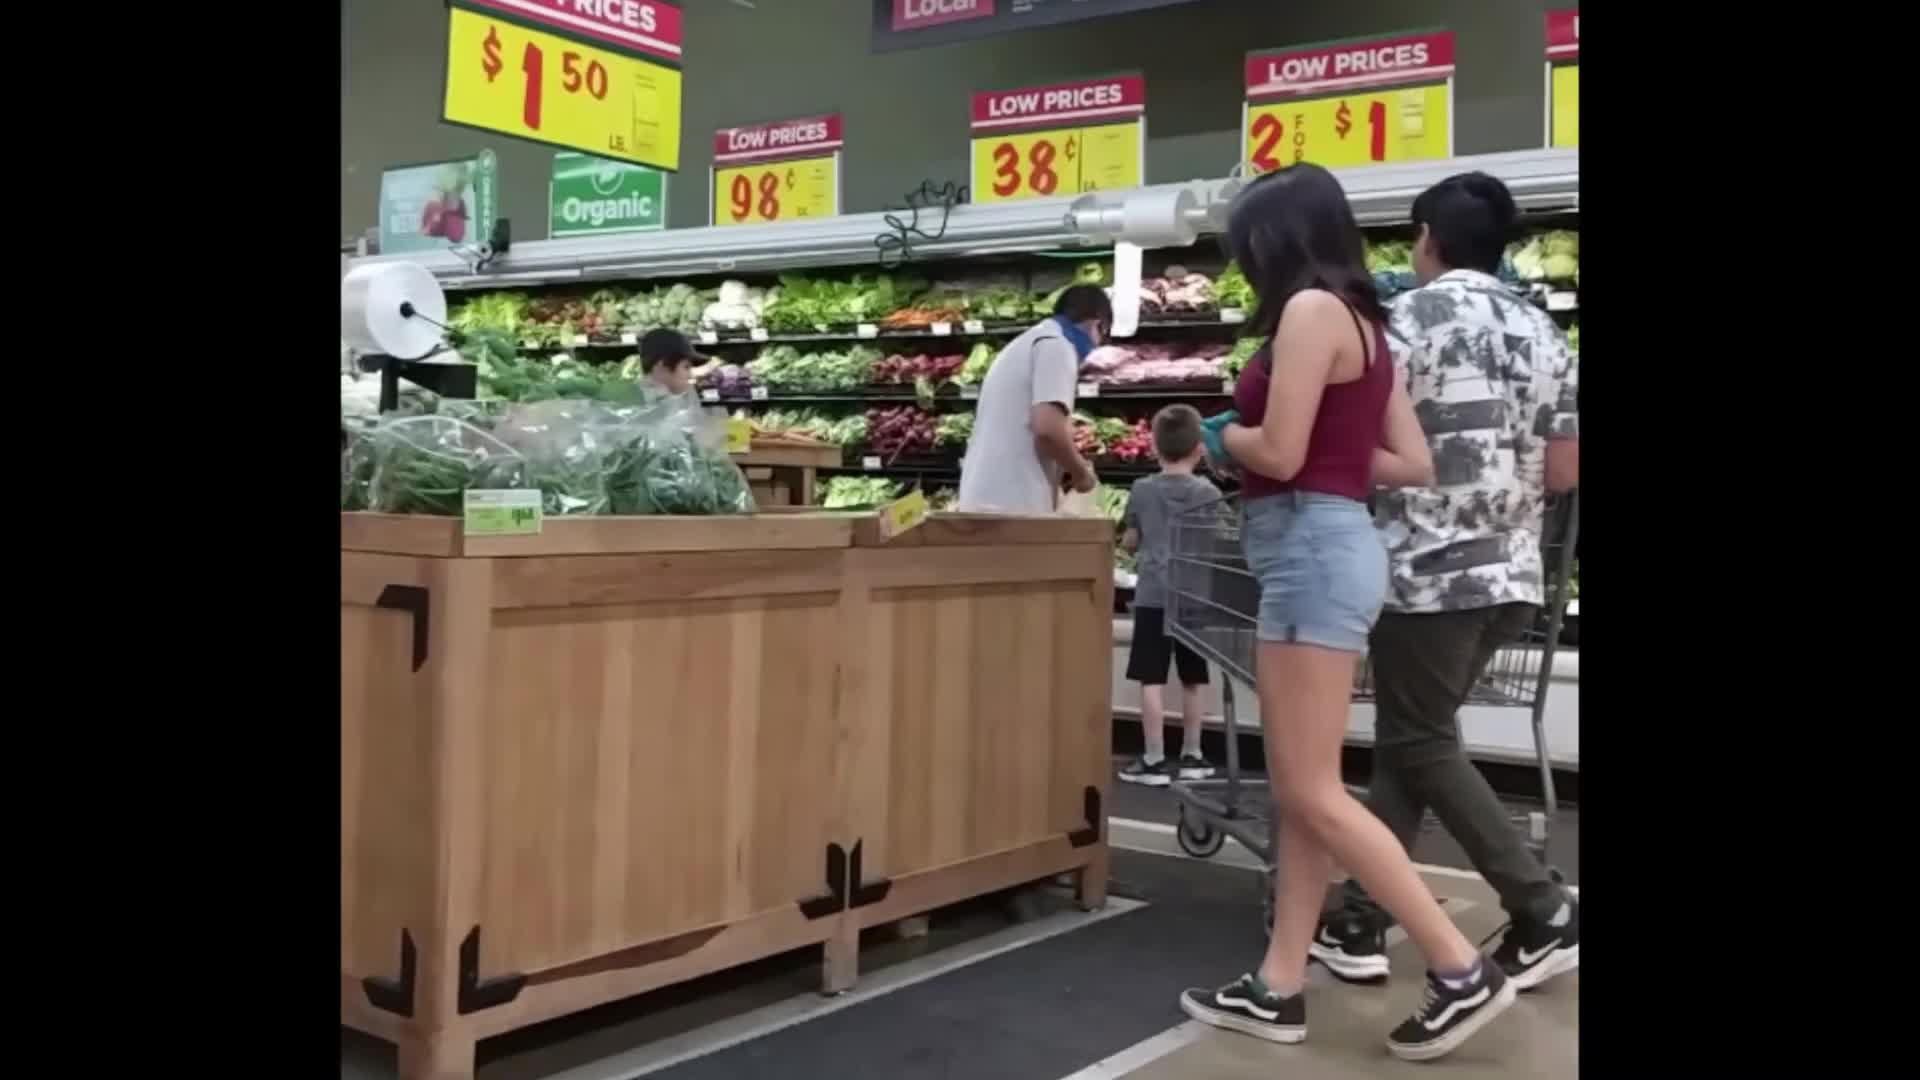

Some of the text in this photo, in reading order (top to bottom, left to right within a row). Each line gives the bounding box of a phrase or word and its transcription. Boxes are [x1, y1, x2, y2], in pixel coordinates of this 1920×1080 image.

[556, 0, 656, 32] RICES
[1268, 43, 1429, 83] LOW PRICES
[988, 84, 1123, 117] LOW PRICES
[728, 122, 828, 151] LOW PRICES
[1251, 113, 1283, 173] 2
[562, 191, 651, 226] Organic
